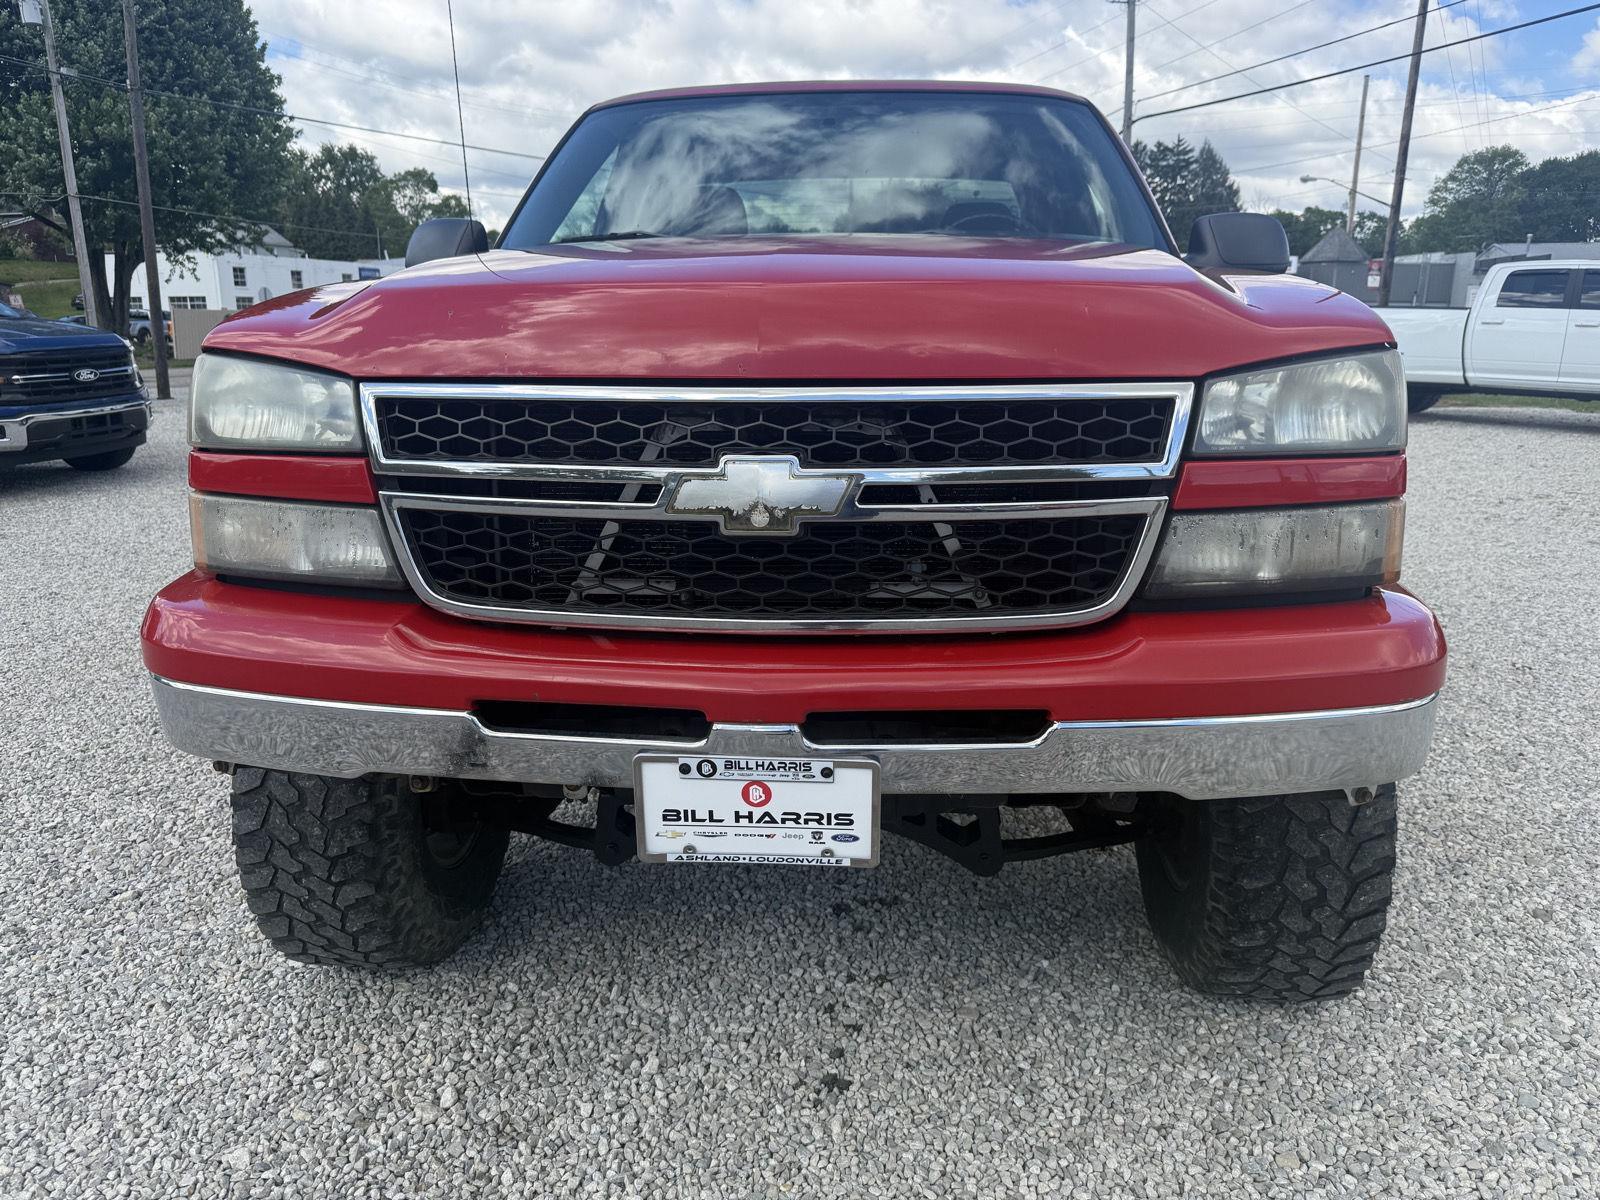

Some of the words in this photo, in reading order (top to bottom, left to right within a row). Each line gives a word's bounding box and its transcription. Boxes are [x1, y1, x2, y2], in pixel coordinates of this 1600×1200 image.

[724, 760, 754, 770] BILL
[755, 761, 812, 772] HARRIS
[661, 808, 725, 823] BILL
[734, 810, 855, 826] HARRIS
[782, 832, 804, 840] Jeep
[749, 856, 844, 865] LOUDONVILLE
